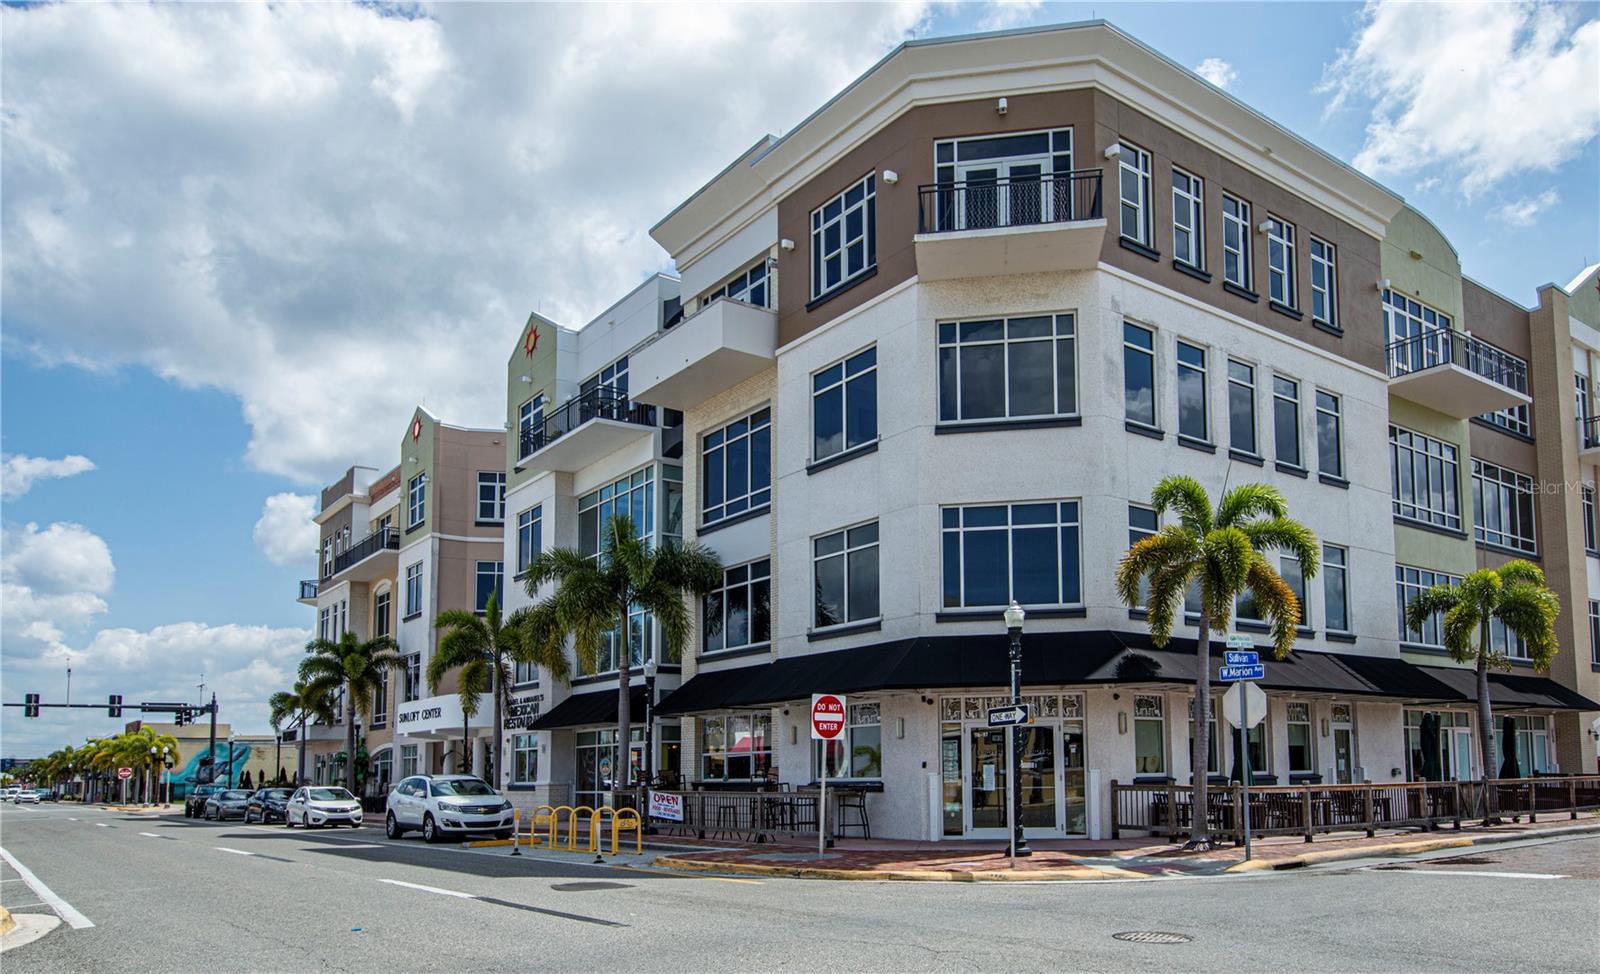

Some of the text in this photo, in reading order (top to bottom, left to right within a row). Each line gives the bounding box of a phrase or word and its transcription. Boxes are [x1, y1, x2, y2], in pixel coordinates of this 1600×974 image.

[1228, 653, 1249, 663] Sullivan
[510, 703, 539, 716] MEXICAN
[817, 703, 826, 711] DO
[399, 707, 441, 723] SUNLOFT CENTER
[991, 711, 1016, 721] ONE WAY
[653, 793, 679, 805] OPEN
